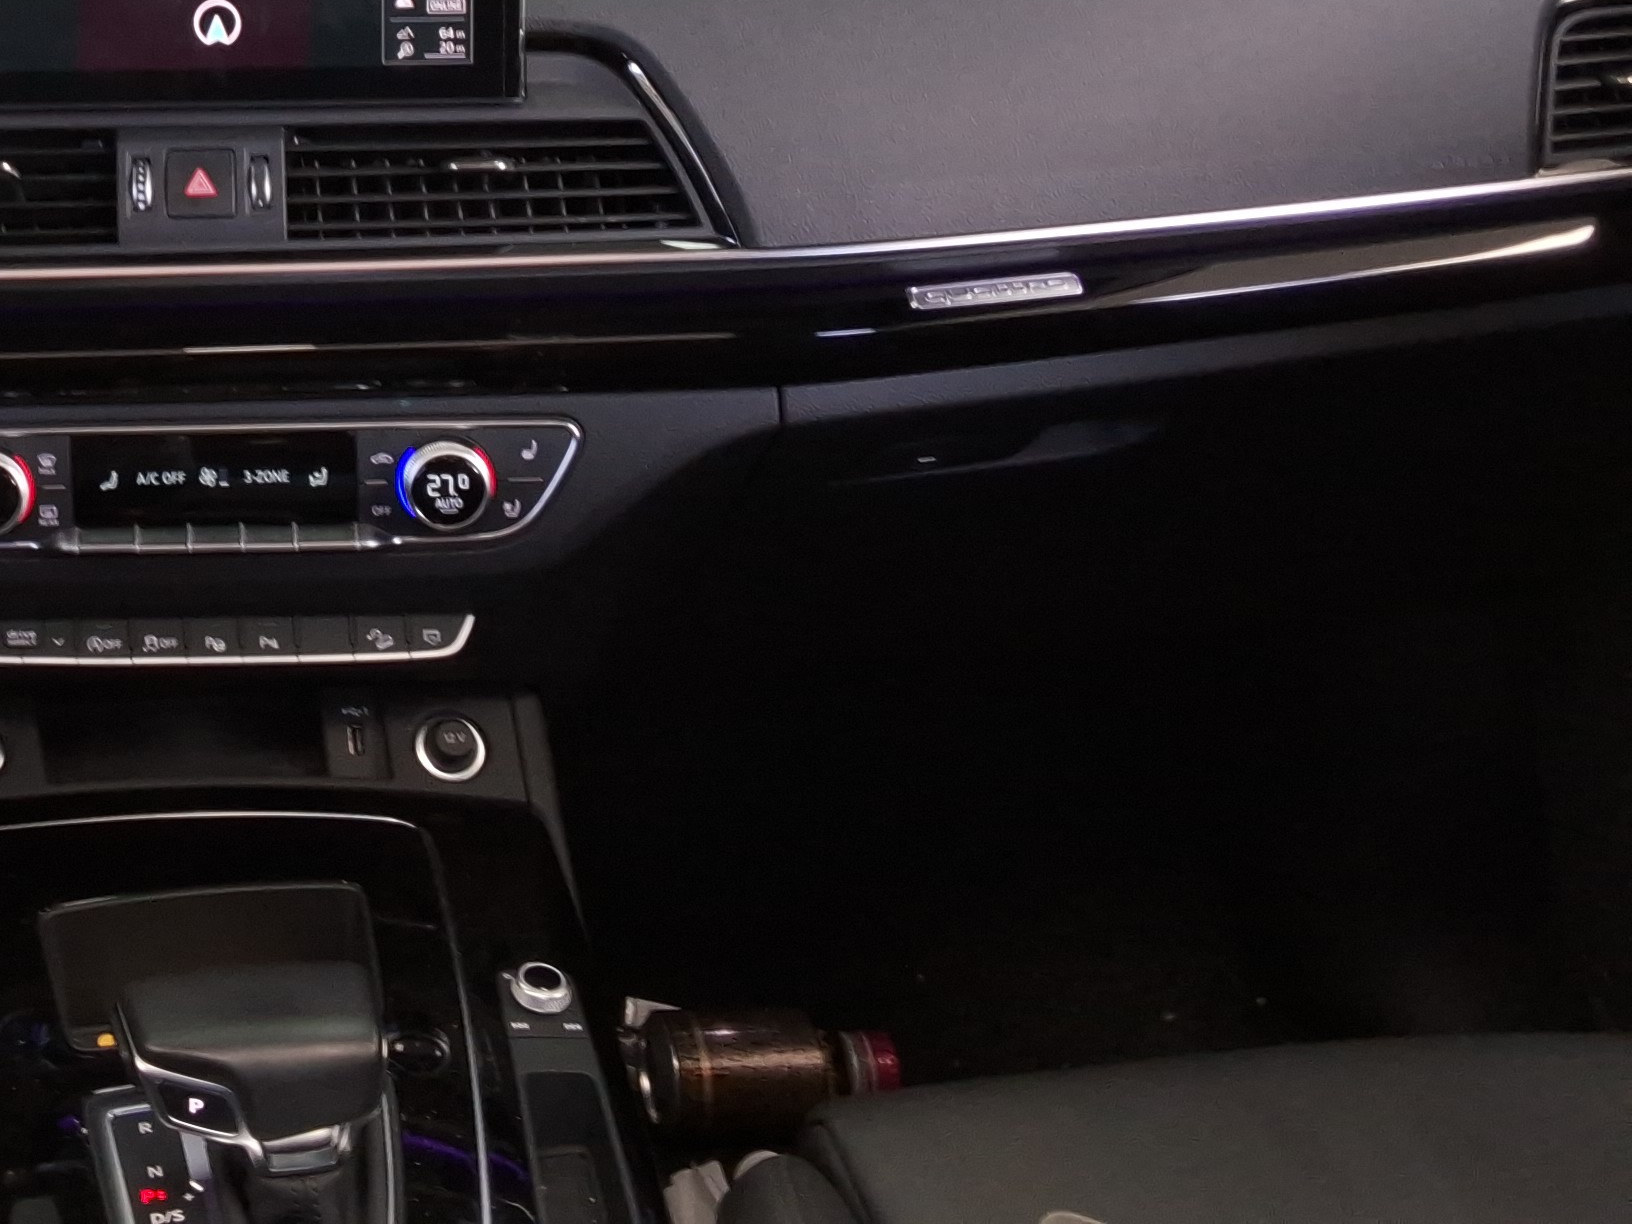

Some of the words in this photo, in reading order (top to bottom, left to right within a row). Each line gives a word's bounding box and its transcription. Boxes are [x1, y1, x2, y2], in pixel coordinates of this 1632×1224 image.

[438, 26, 455, 39] 64
[136, 471, 160, 486] A/C
[161, 470, 187, 485] OFF
[242, 468, 291, 484] 3-ZONE
[188, 1097, 205, 1115] P
[137, 1121, 154, 1135] R
[146, 1164, 165, 1179] N
[149, 1208, 186, 1224] D/S
